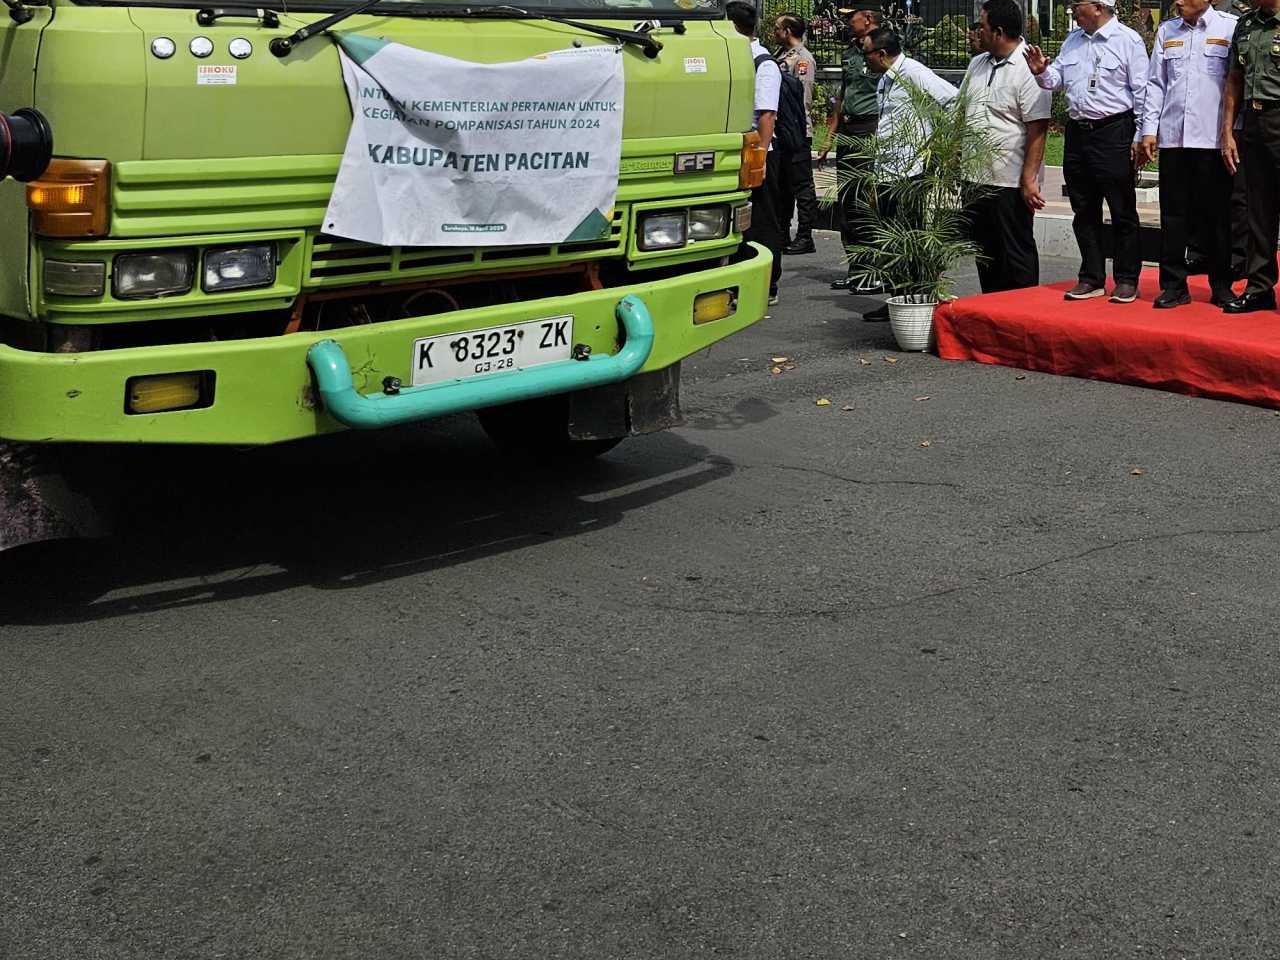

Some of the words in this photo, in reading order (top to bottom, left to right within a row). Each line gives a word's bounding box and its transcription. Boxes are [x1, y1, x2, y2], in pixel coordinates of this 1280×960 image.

[411, 100, 509, 113] KEMENTERIAN
[511, 100, 576, 113] PERTANIAN
[579, 100, 617, 112] UNTUK
[435, 119, 526, 132] POMPANISASI
[527, 119, 568, 130] TAHUN
[570, 119, 600, 129] 2024
[368, 143, 499, 173] KABUPATEN
[504, 151, 590, 171] PACITAN
[418, 341, 435, 370] K
[455, 328, 517, 362] 8323
[539, 320, 569, 349] ZK
